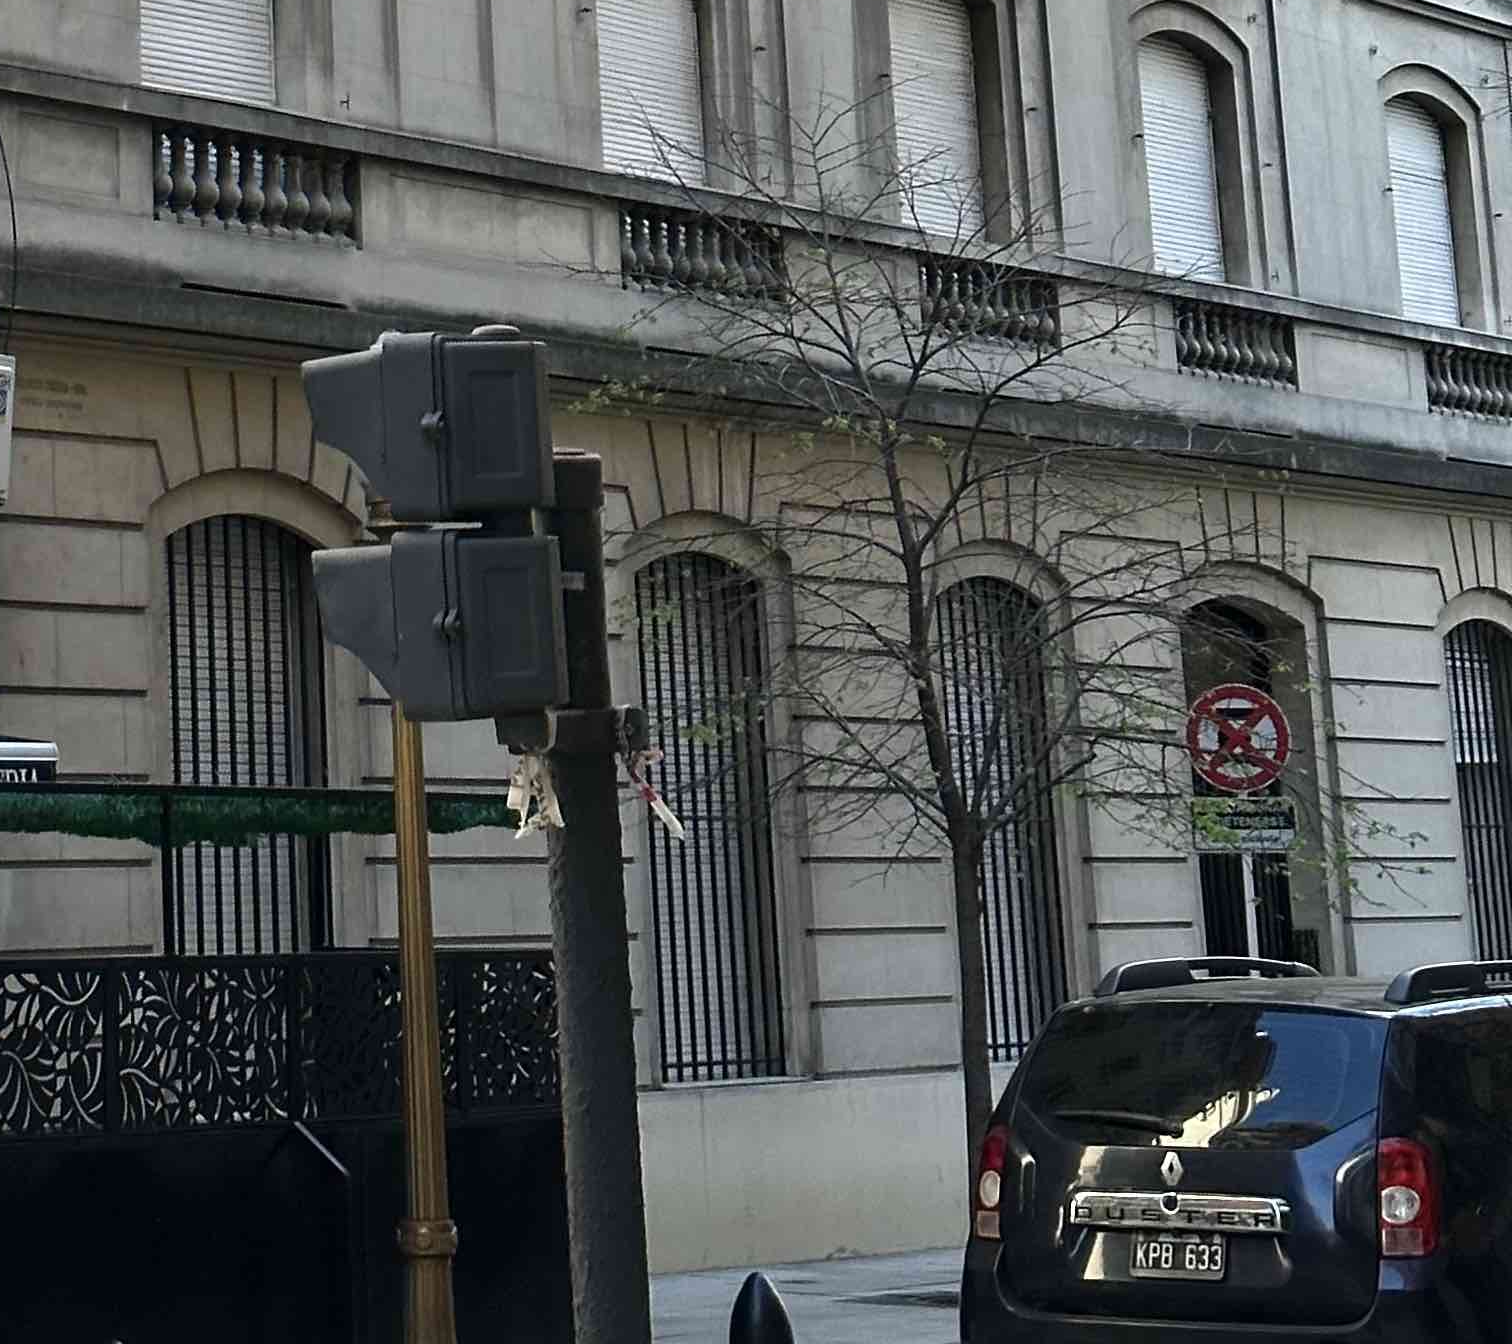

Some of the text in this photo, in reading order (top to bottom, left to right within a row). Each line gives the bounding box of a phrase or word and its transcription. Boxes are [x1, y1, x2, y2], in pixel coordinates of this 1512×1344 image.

[1075, 1206, 1276, 1228] DUSTER
[1136, 1242, 1222, 1271] KPB 633
